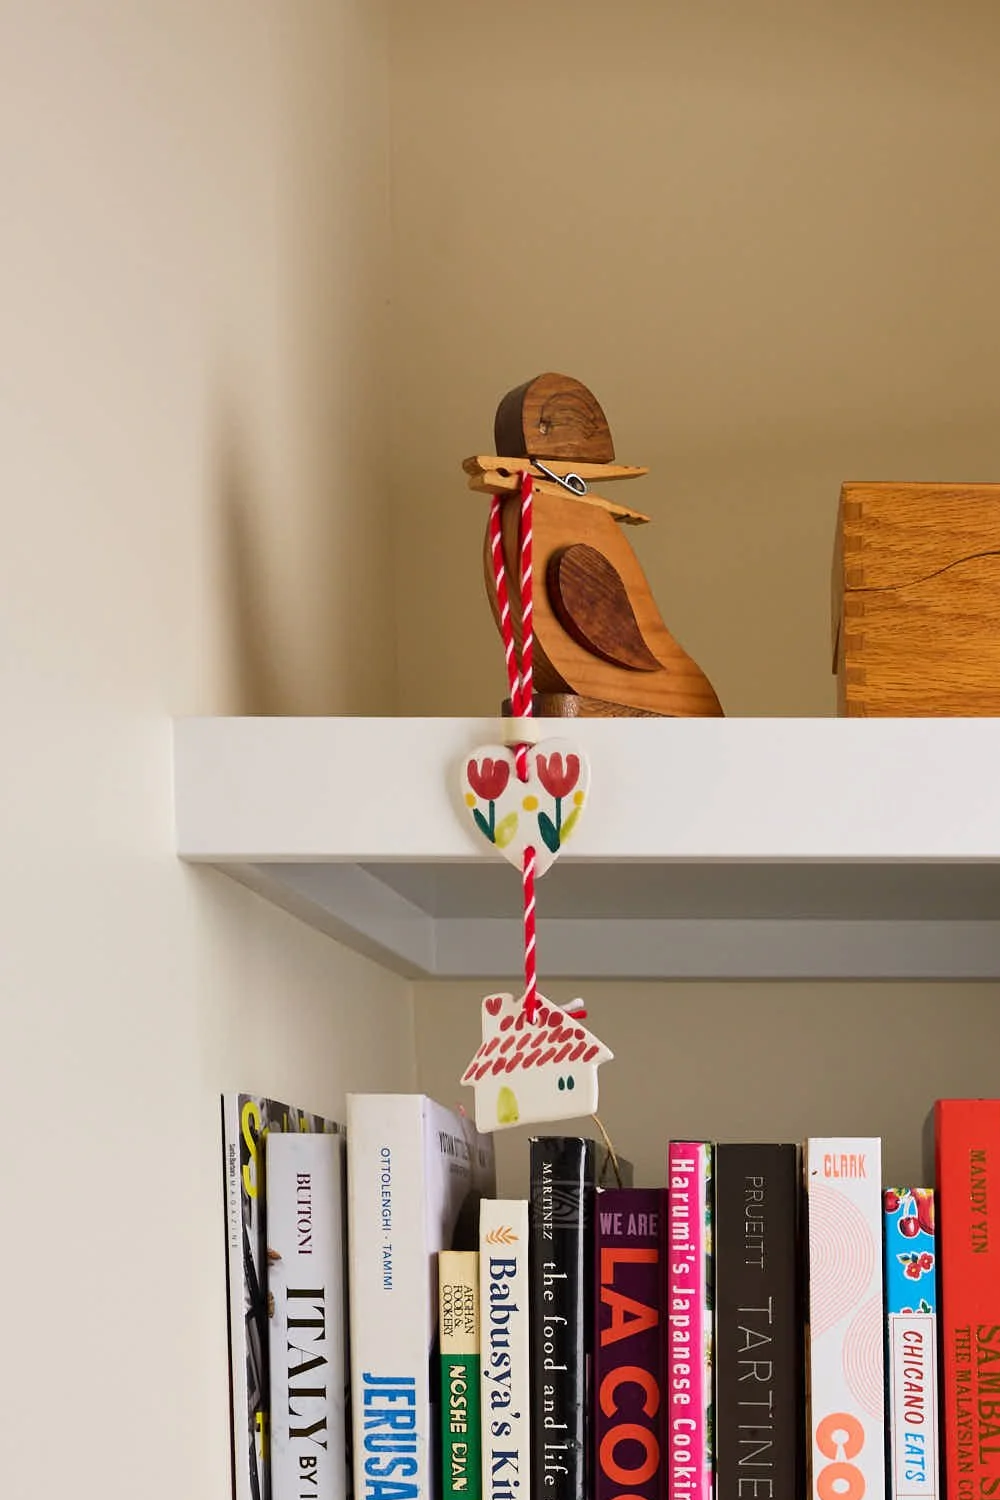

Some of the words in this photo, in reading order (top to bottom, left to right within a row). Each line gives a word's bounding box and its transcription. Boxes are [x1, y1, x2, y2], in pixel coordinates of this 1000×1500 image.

[381, 1147, 393, 1231] OTTOLENGHI
[542, 1161, 553, 1241] MARTINEZ
[824, 1154, 866, 1178] CLARK
[296, 1173, 313, 1255] BUITONI
[600, 1213, 624, 1235] WE
[627, 1213, 658, 1236] ARE
[671, 1159, 696, 1274] Harumi's
[745, 1176, 764, 1272] PRUEITT
[382, 1244, 393, 1291] TAMIMI
[543, 1262, 568, 1301] the
[600, 1247, 659, 1347] LA
[286, 1287, 329, 1451] ITALY
[543, 1315, 568, 1371] food
[669, 1285, 696, 1405] Japanese
[903, 1330, 925, 1424] CHICANO
[448, 1364, 468, 1435] NOSHE
[544, 1385, 568, 1429] and
[737, 1296, 773, 1498] TARTINE
[299, 1456, 318, 1486] BY
[451, 1442, 468, 1491] DJAN
[544, 1442, 569, 1486] life
[904, 1431, 926, 1483] EATS
